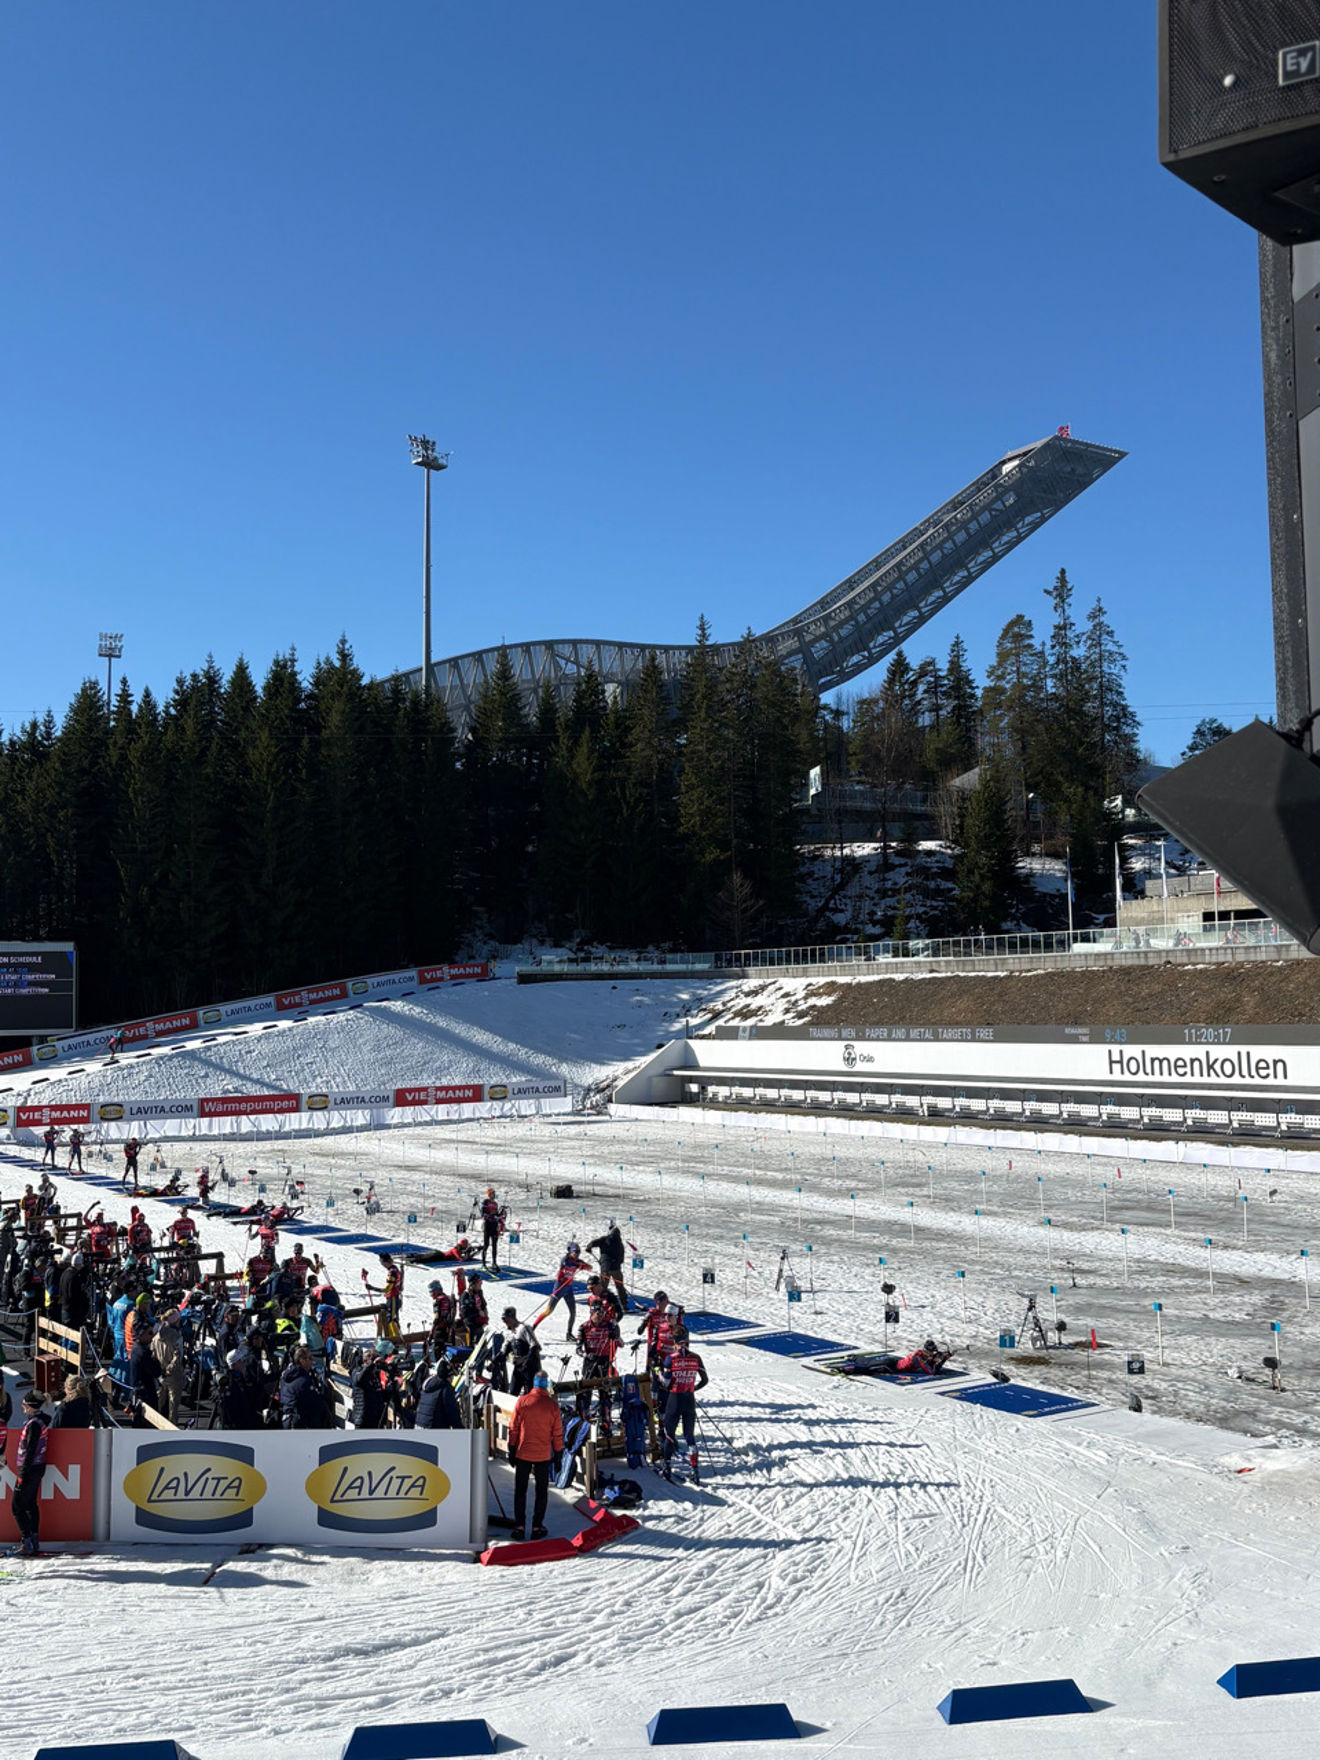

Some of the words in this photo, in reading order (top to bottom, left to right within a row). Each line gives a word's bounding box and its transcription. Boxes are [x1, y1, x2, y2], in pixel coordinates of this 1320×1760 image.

[372, 975, 415, 989] LAVITA.COM
[225, 1001, 273, 1017] LAVITA.COM
[809, 1028, 838, 1039] TRAINING
[841, 1028, 856, 1039] MEN
[865, 1028, 888, 1039] PAPER
[891, 1028, 906, 1039] AND
[909, 1028, 934, 1040] METAL
[937, 1029, 972, 1040] TARGETS
[975, 1029, 994, 1040] FREE
[1104, 1028, 1127, 1042] 9:43
[1184, 1028, 1232, 1043] 11:20:17
[859, 1053, 875, 1064] Oslo
[1108, 1049, 1288, 1080] Holmenkollen
[512, 1084, 562, 1096] LAVITA.COM
[203, 1099, 297, 1114] Wärmepumpen
[333, 1095, 390, 1106] LAVITA.COM
[130, 1104, 194, 1116] LAVITA.COM
